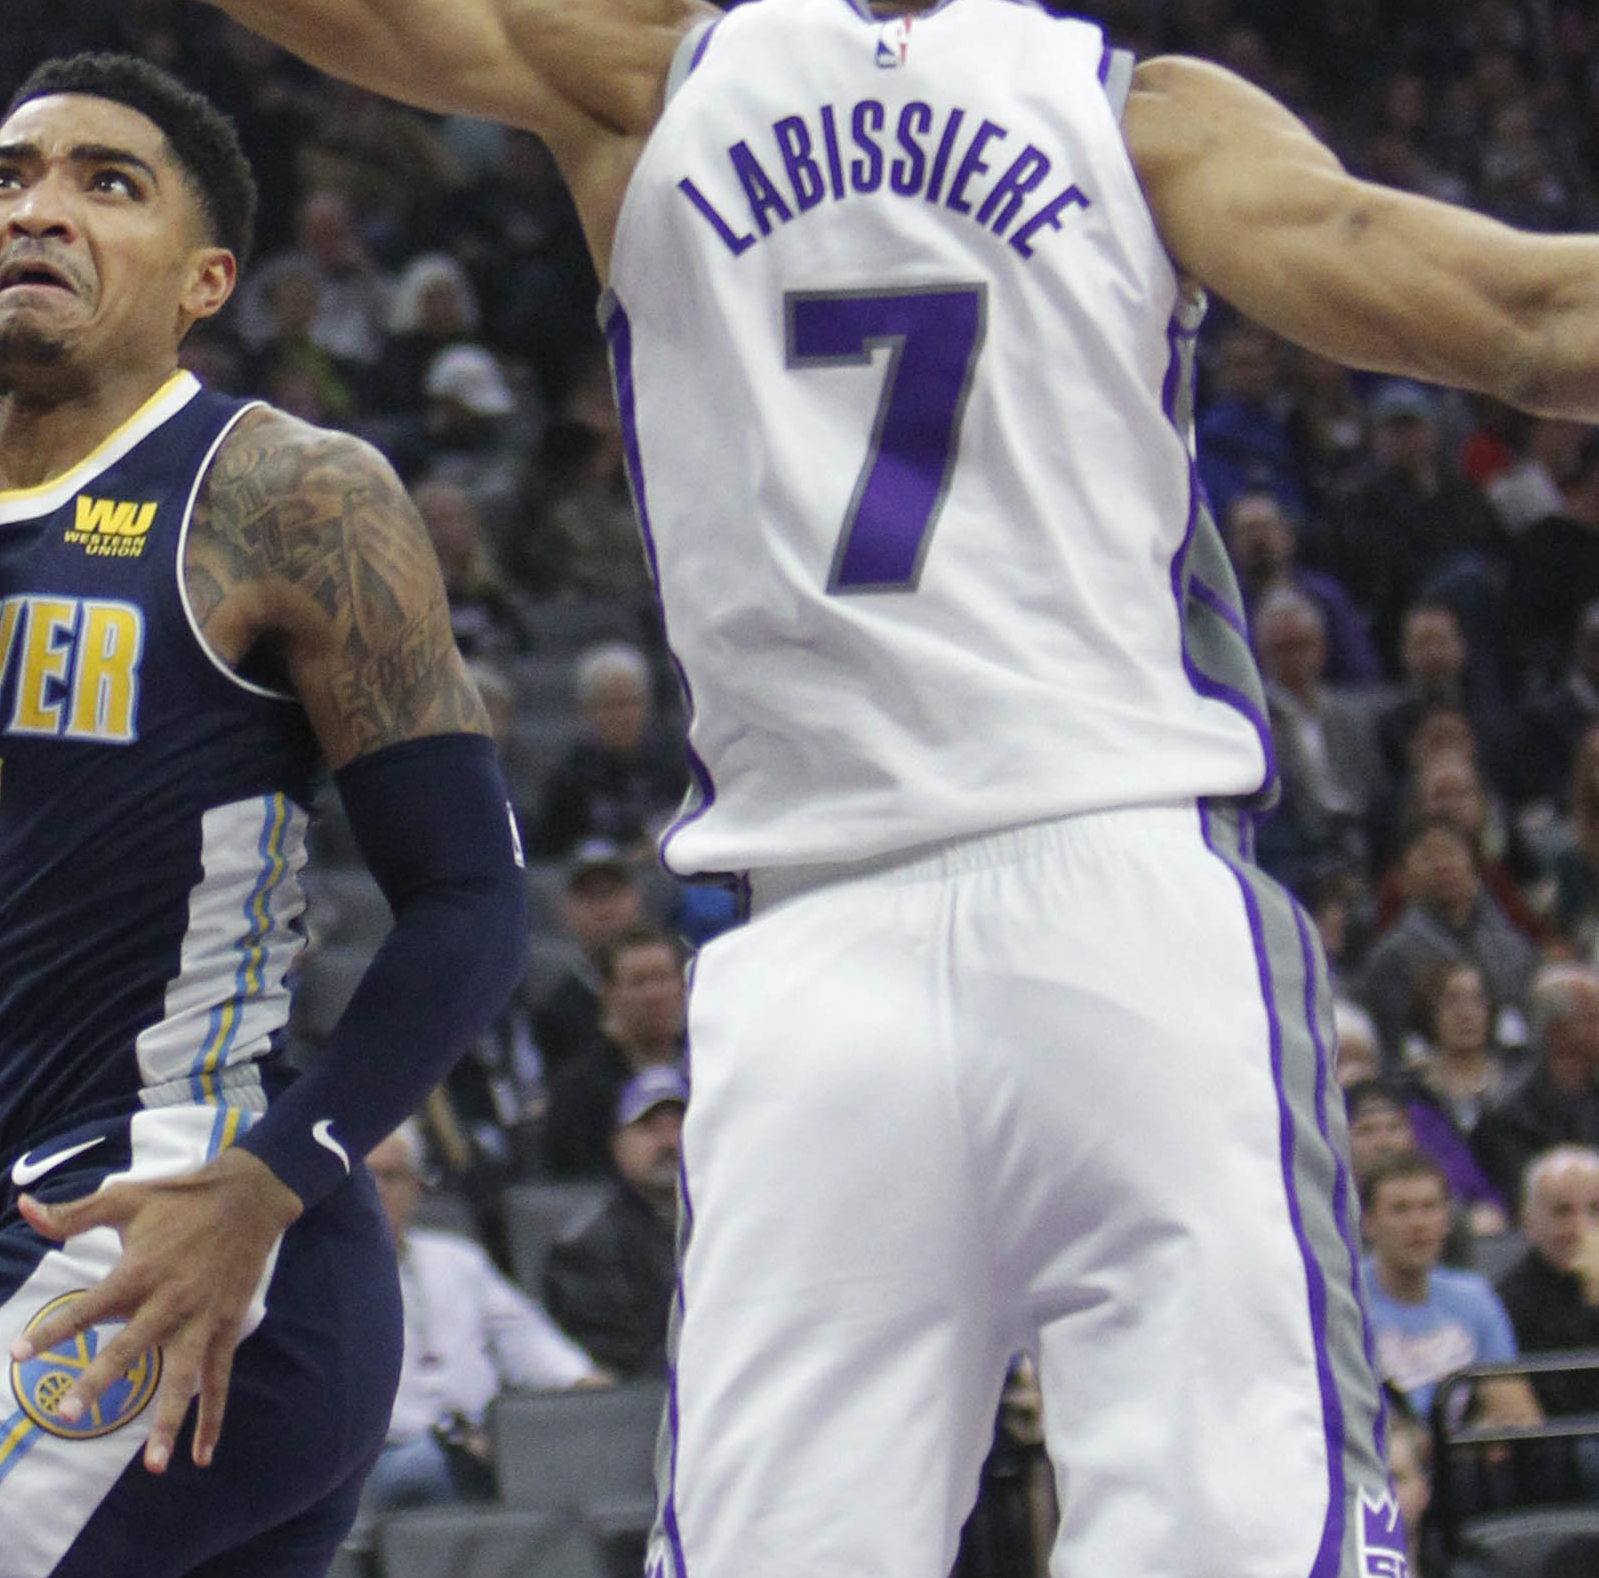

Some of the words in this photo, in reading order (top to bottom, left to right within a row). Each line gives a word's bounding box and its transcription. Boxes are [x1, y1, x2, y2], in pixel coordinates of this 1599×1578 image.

[677, 99, 1091, 261] LABISSIERE
[783, 281, 989, 596] 7
[74, 493, 158, 537] WU
[63, 529, 147, 548] WESTERN
[84, 543, 143, 559] UNION
